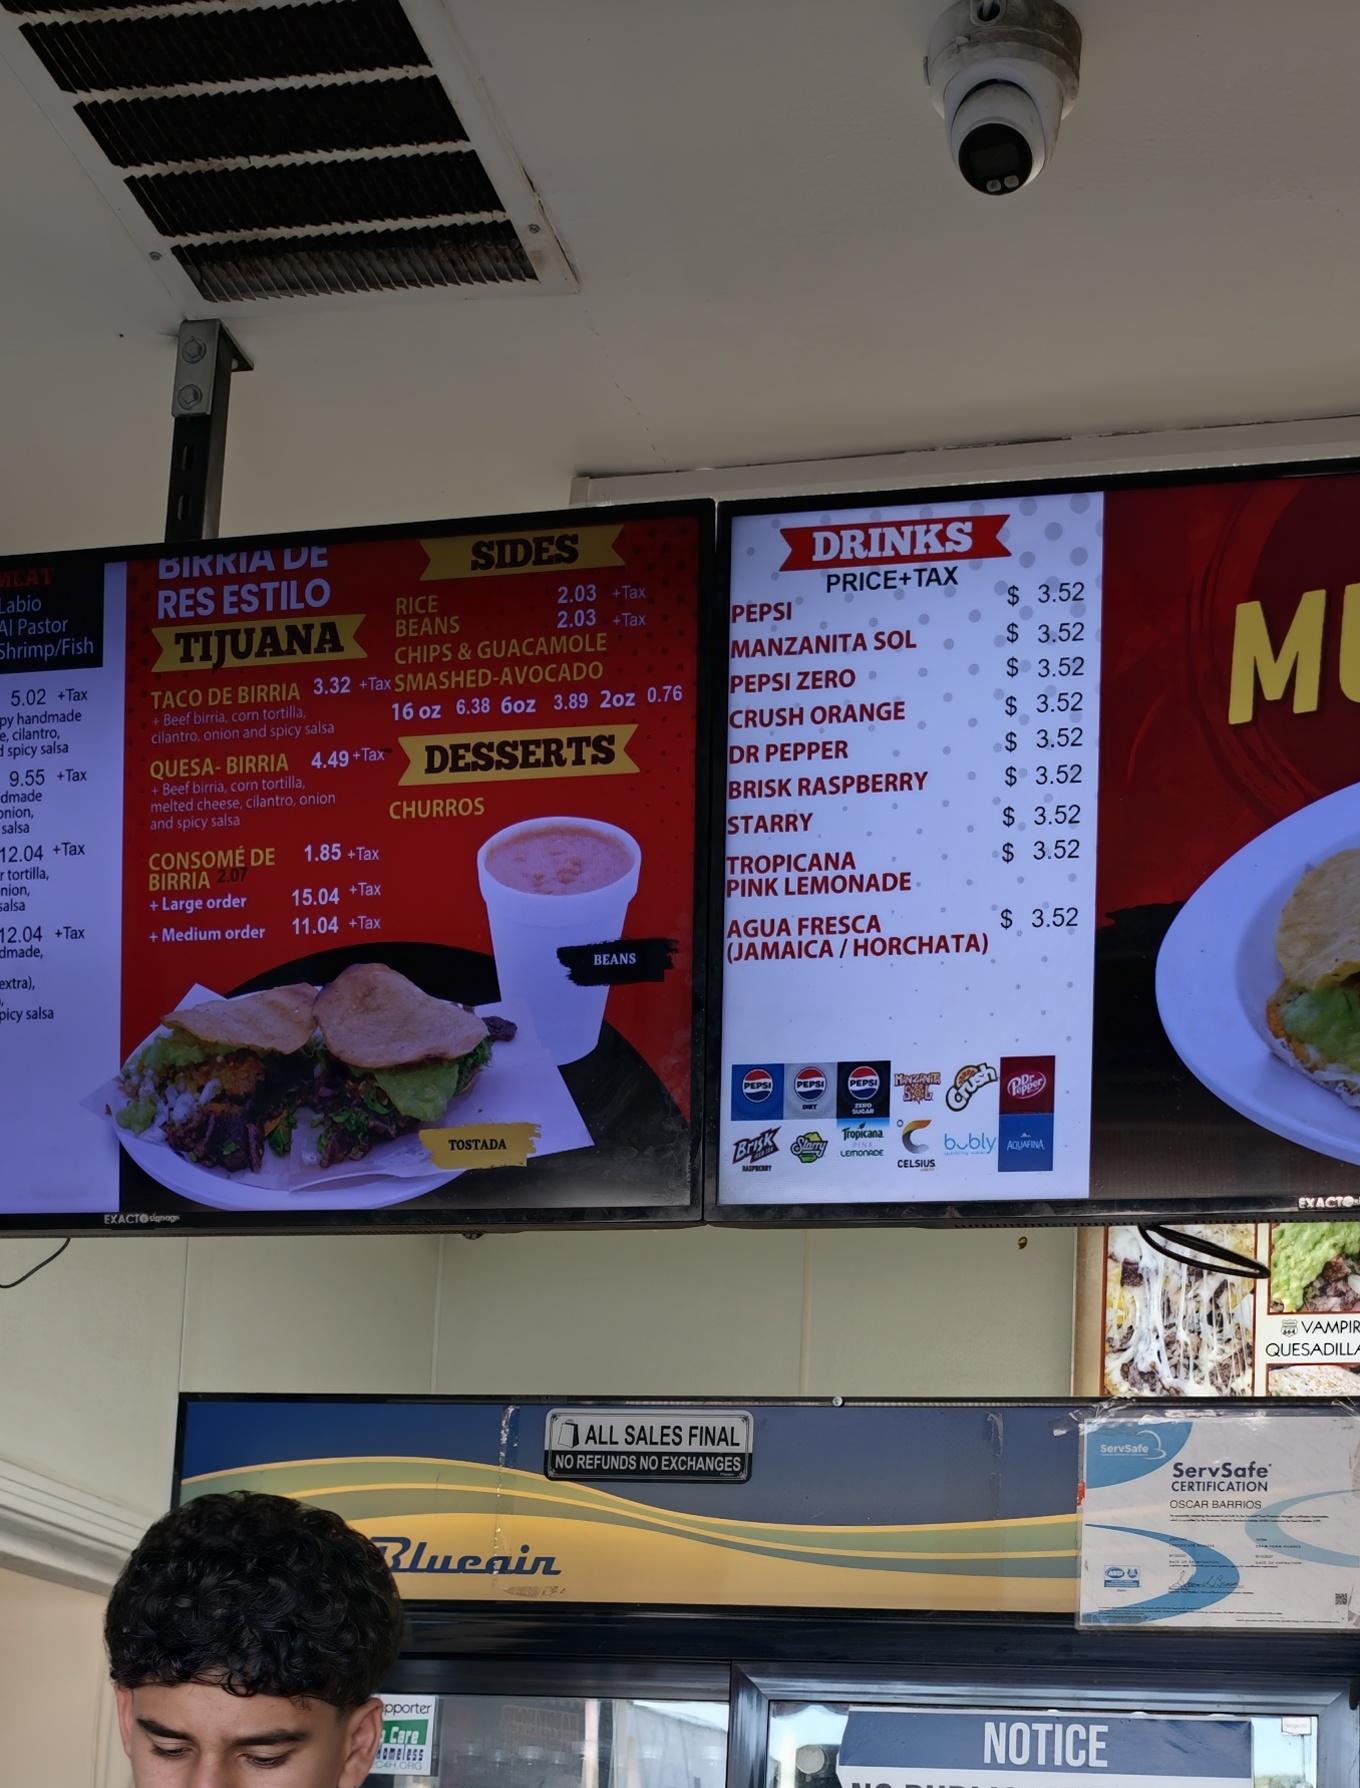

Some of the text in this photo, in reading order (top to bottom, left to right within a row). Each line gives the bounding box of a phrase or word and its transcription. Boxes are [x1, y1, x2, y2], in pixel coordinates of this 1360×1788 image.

[471, 534, 579, 571] SIDES
[812, 521, 973, 562] DRINKS
[158, 545, 328, 580] BIRRIA DE
[826, 566, 958, 593] PRICE+TAX
[158, 578, 330, 619] RES ESTILO
[396, 584, 646, 615] RICE 2.03 +Tax
[731, 581, 1085, 624] PEPSI $ 3.52
[18, 618, 68, 635] Pastor
[395, 616, 460, 638] BEANS
[174, 621, 344, 672] TIJUANA
[395, 633, 607, 664] CHIPS & GUACAMOLE
[731, 630, 917, 658] MANZANITA SOL
[394, 661, 603, 692] SMASHED-AVOCADO
[730, 669, 856, 693] PEPSI ZERO
[11, 688, 46, 707] 5.02
[151, 676, 351, 709] TACO DE BIRRIA 3.32
[392, 685, 682, 721] 16 oz 6.38 6oz 3.89 2oz 0.76
[730, 701, 905, 728] CRUSH ORANGE
[227, 753, 289, 774] BIRRIA
[311, 750, 349, 769] 4.49
[425, 734, 615, 774] DESSERTS
[728, 740, 848, 764] DR PEPPER
[9, 769, 45, 787] 9.55
[728, 771, 928, 800] BRISK RASPBERRY
[389, 797, 485, 819] CHURROS
[728, 813, 813, 834] STARRY
[149, 843, 341, 871] CONSOMÉ DE 1.85
[727, 851, 856, 874] TROPICANA
[149, 871, 210, 891] BIRRIA
[727, 872, 911, 897] PINK LEMONADE
[162, 887, 340, 914] Large order 15.04
[726, 914, 881, 939] AGUA FRESCA
[593, 953, 636, 965] BEANS
[727, 933, 988, 964] (JAMAICA / HORCHATA)
[744, 1081, 771, 1091] PEPSI
[849, 1079, 878, 1088] PEPSI
[448, 1138, 507, 1151] TOSTADA
[1007, 1140, 1045, 1150] AQUAFINA
[897, 1159, 936, 1168] CELSIUS
[584, 1424, 740, 1447] ALL SALES FINAL
[1100, 1443, 1149, 1453] ServSafe
[555, 1454, 741, 1473] NO REFUNDS NO EXCHANGES
[1173, 1461, 1268, 1478] ServSafe
[1171, 1481, 1268, 1492] CERTIFICATION
[1169, 1499, 1262, 1510] OSCAR BARRIOS
[384, 1702, 431, 1715] pporter
[984, 1722, 1108, 1767] NOTICE
